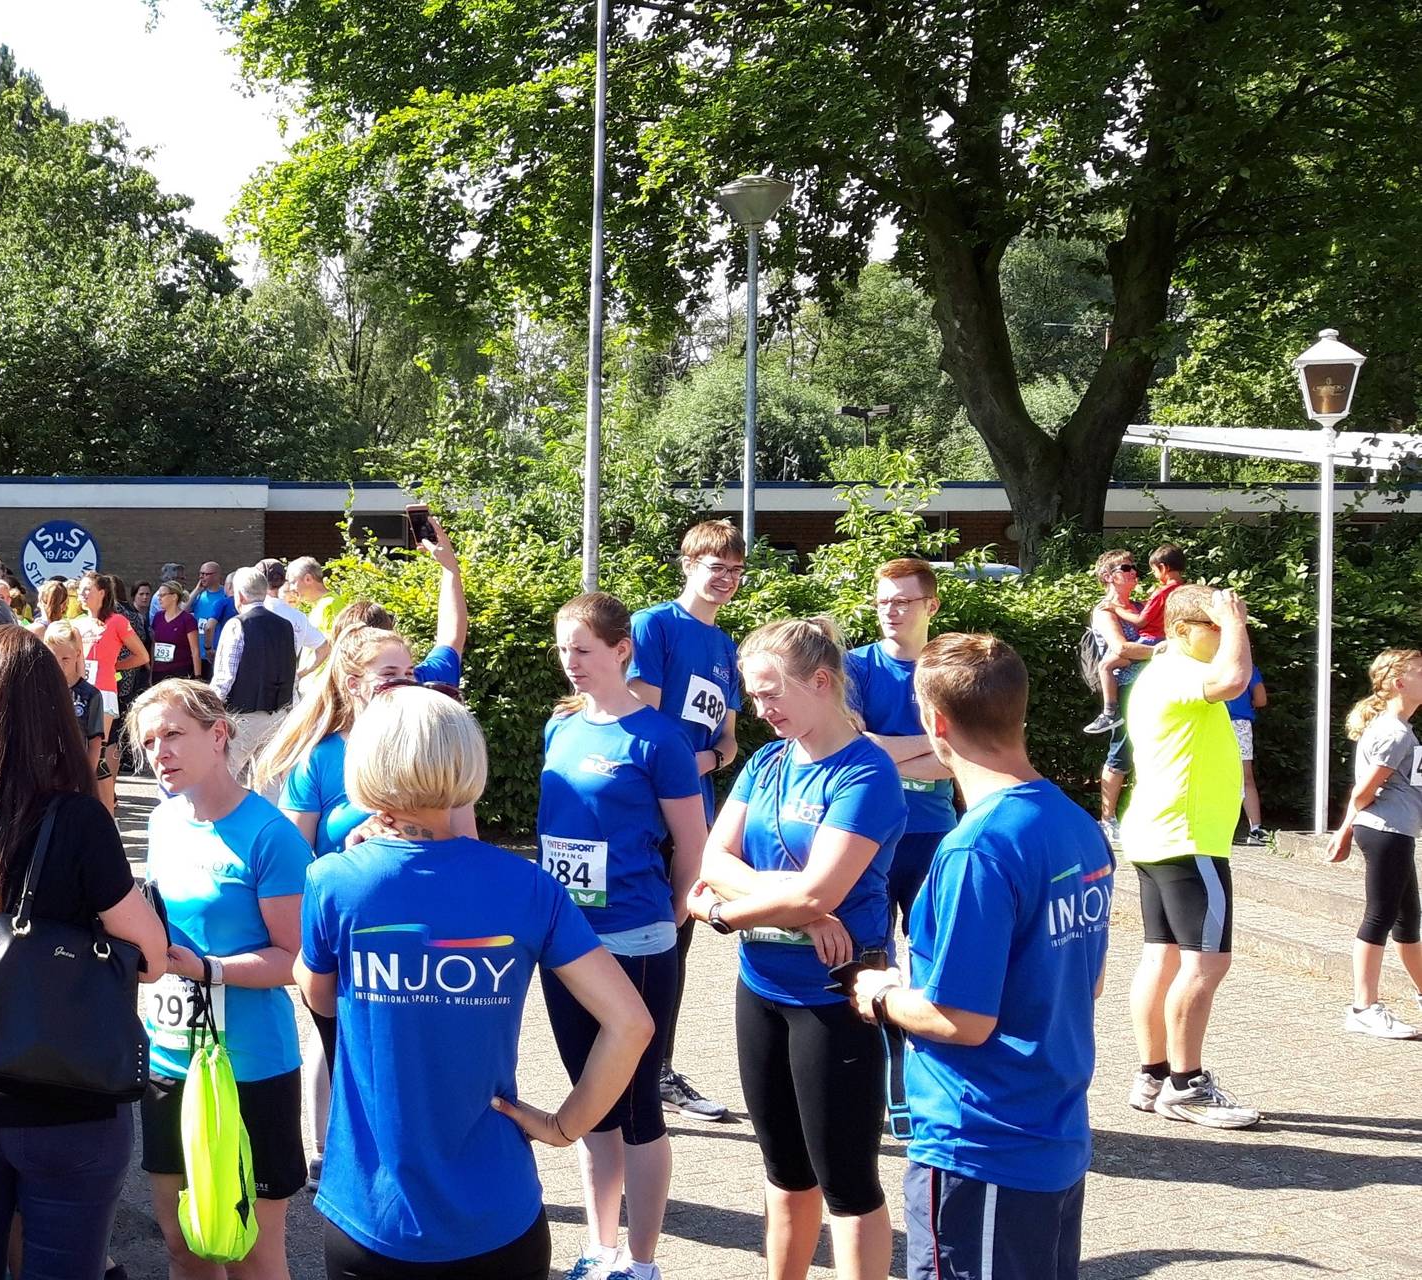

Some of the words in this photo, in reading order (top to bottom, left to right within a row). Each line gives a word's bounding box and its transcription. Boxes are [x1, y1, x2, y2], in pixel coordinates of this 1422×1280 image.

[35, 528, 85, 549] SuS
[43, 548, 75, 560] 19/20
[691, 690, 724, 724] 488
[352, 950, 516, 993] INJOY
[154, 993, 207, 1028] 292
[355, 991, 409, 1004] INTERNATIONAL
[445, 996, 451, 1004] &
[454, 996, 511, 1006] WELLNESSCLUBS
